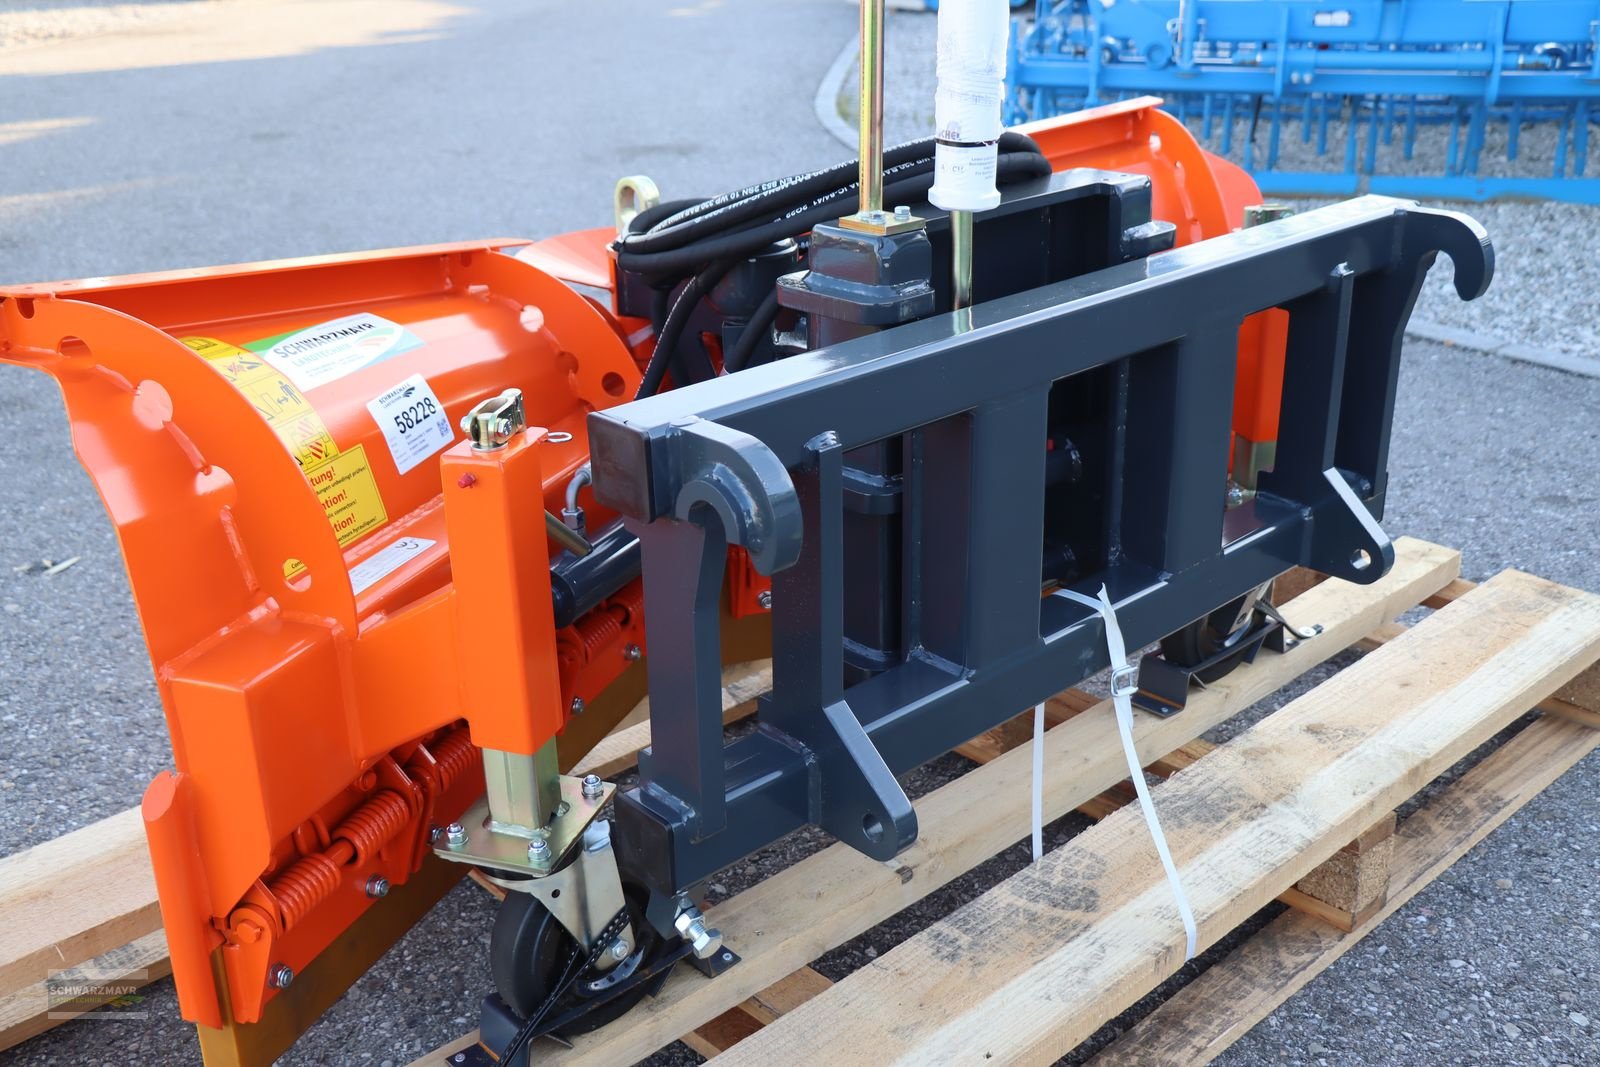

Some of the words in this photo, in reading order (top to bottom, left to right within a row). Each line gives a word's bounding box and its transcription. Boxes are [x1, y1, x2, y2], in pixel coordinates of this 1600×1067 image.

[730, 190, 740, 200] 10
[273, 322, 377, 359] SCHWARZMAYR
[393, 397, 437, 434] 58228
